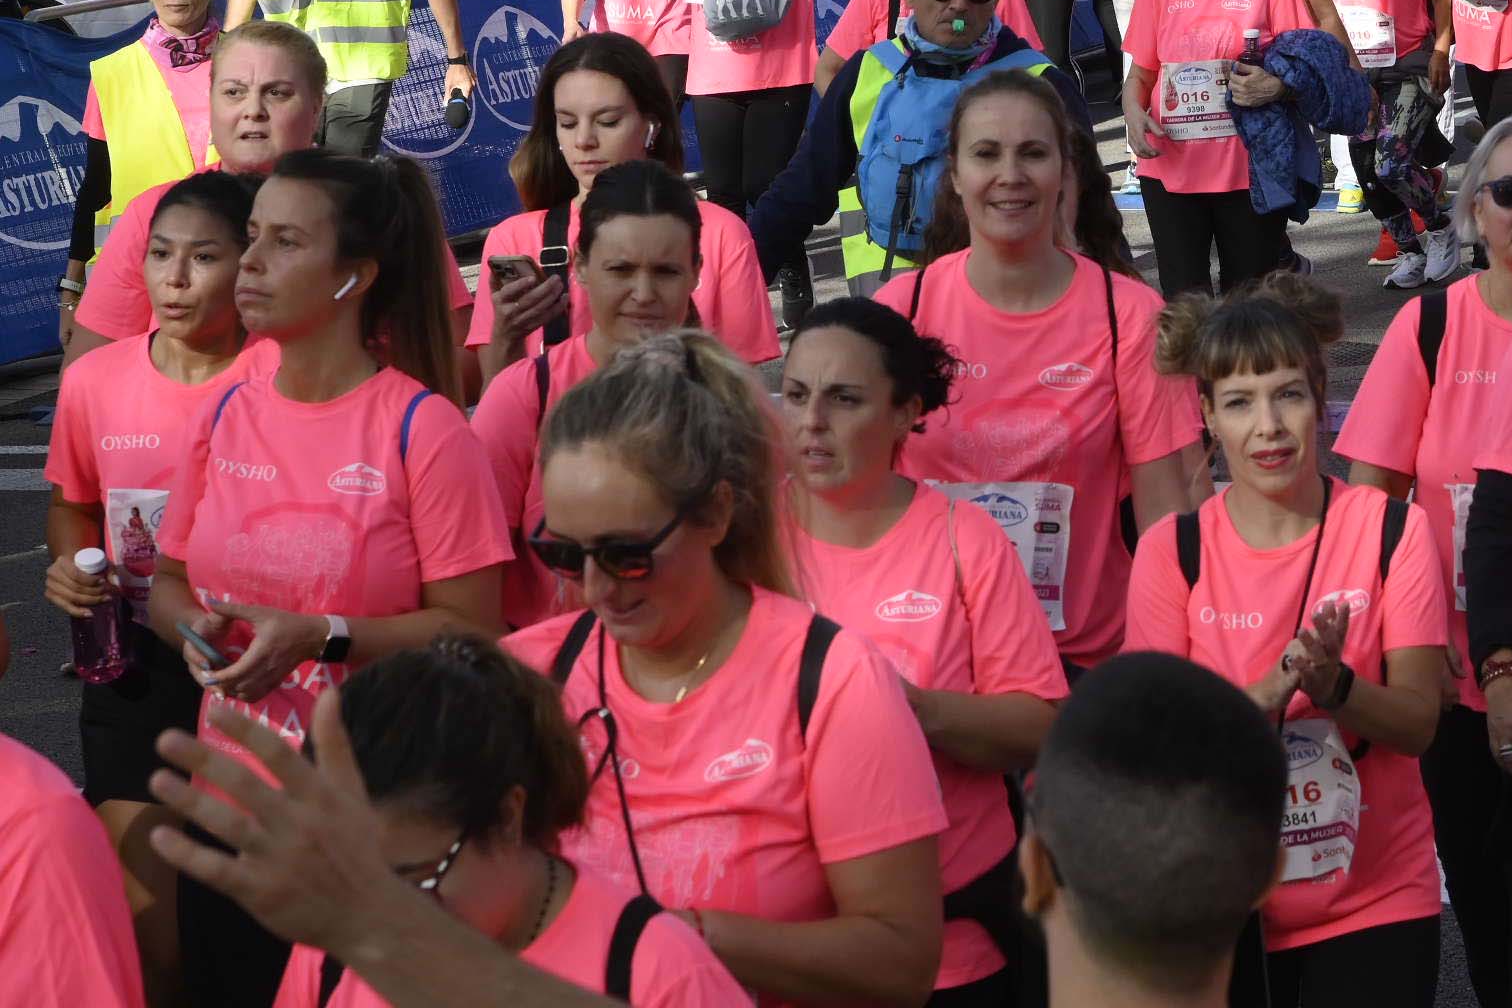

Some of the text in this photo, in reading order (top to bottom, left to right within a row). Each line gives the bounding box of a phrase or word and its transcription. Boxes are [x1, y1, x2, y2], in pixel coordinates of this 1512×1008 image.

[608, 4, 655, 19] SUMA
[1181, 90, 1210, 104] 016
[1186, 105, 1206, 114] 9398
[1455, 370, 1496, 385] OYSH
[101, 433, 161, 451] OYSHO
[883, 604, 938, 617] ASTURIANA
[1288, 780, 1322, 805] 16
[1297, 832, 1309, 842] LA
[1311, 825, 1344, 840] MUJER
